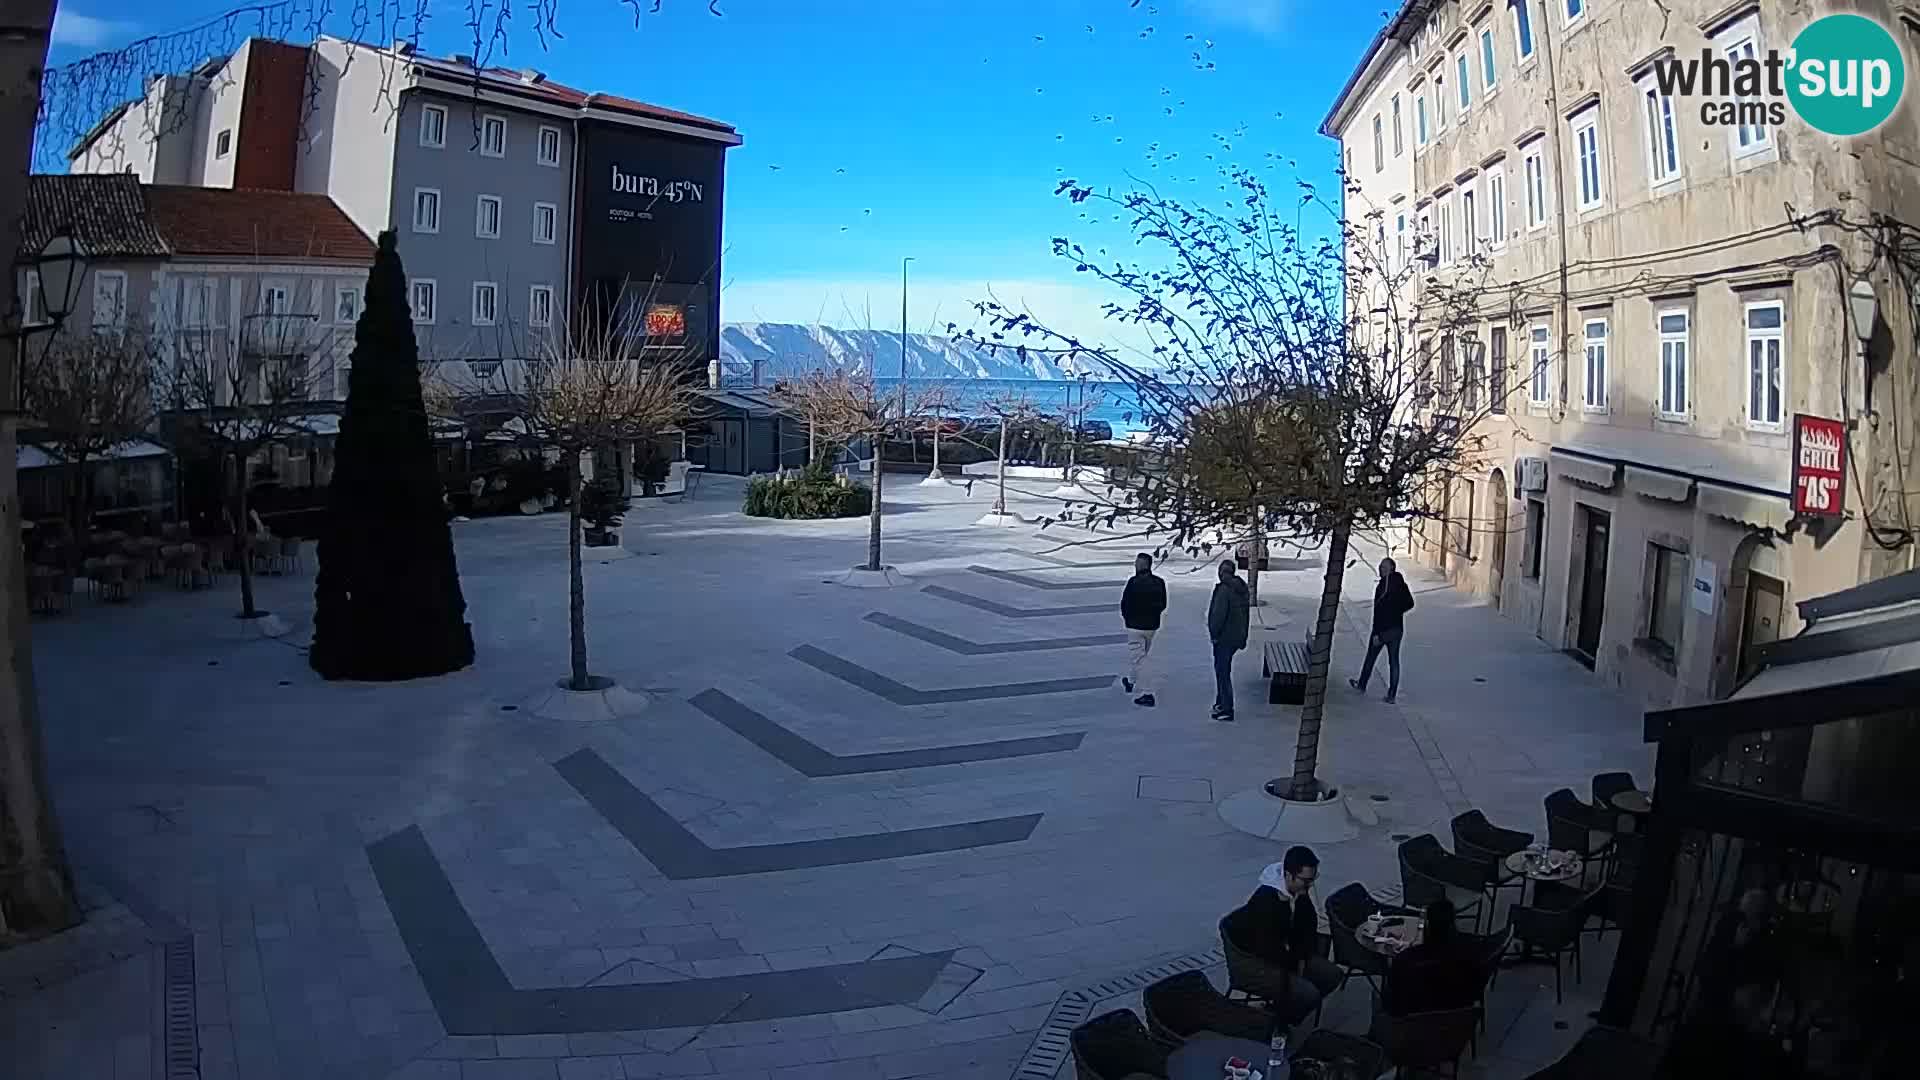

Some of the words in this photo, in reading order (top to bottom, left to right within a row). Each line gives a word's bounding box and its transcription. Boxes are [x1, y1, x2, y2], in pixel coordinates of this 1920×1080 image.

[612, 165, 658, 196] bura
[1800, 447, 1840, 472] GRILL
[1798, 475, 1839, 510] "AS"
